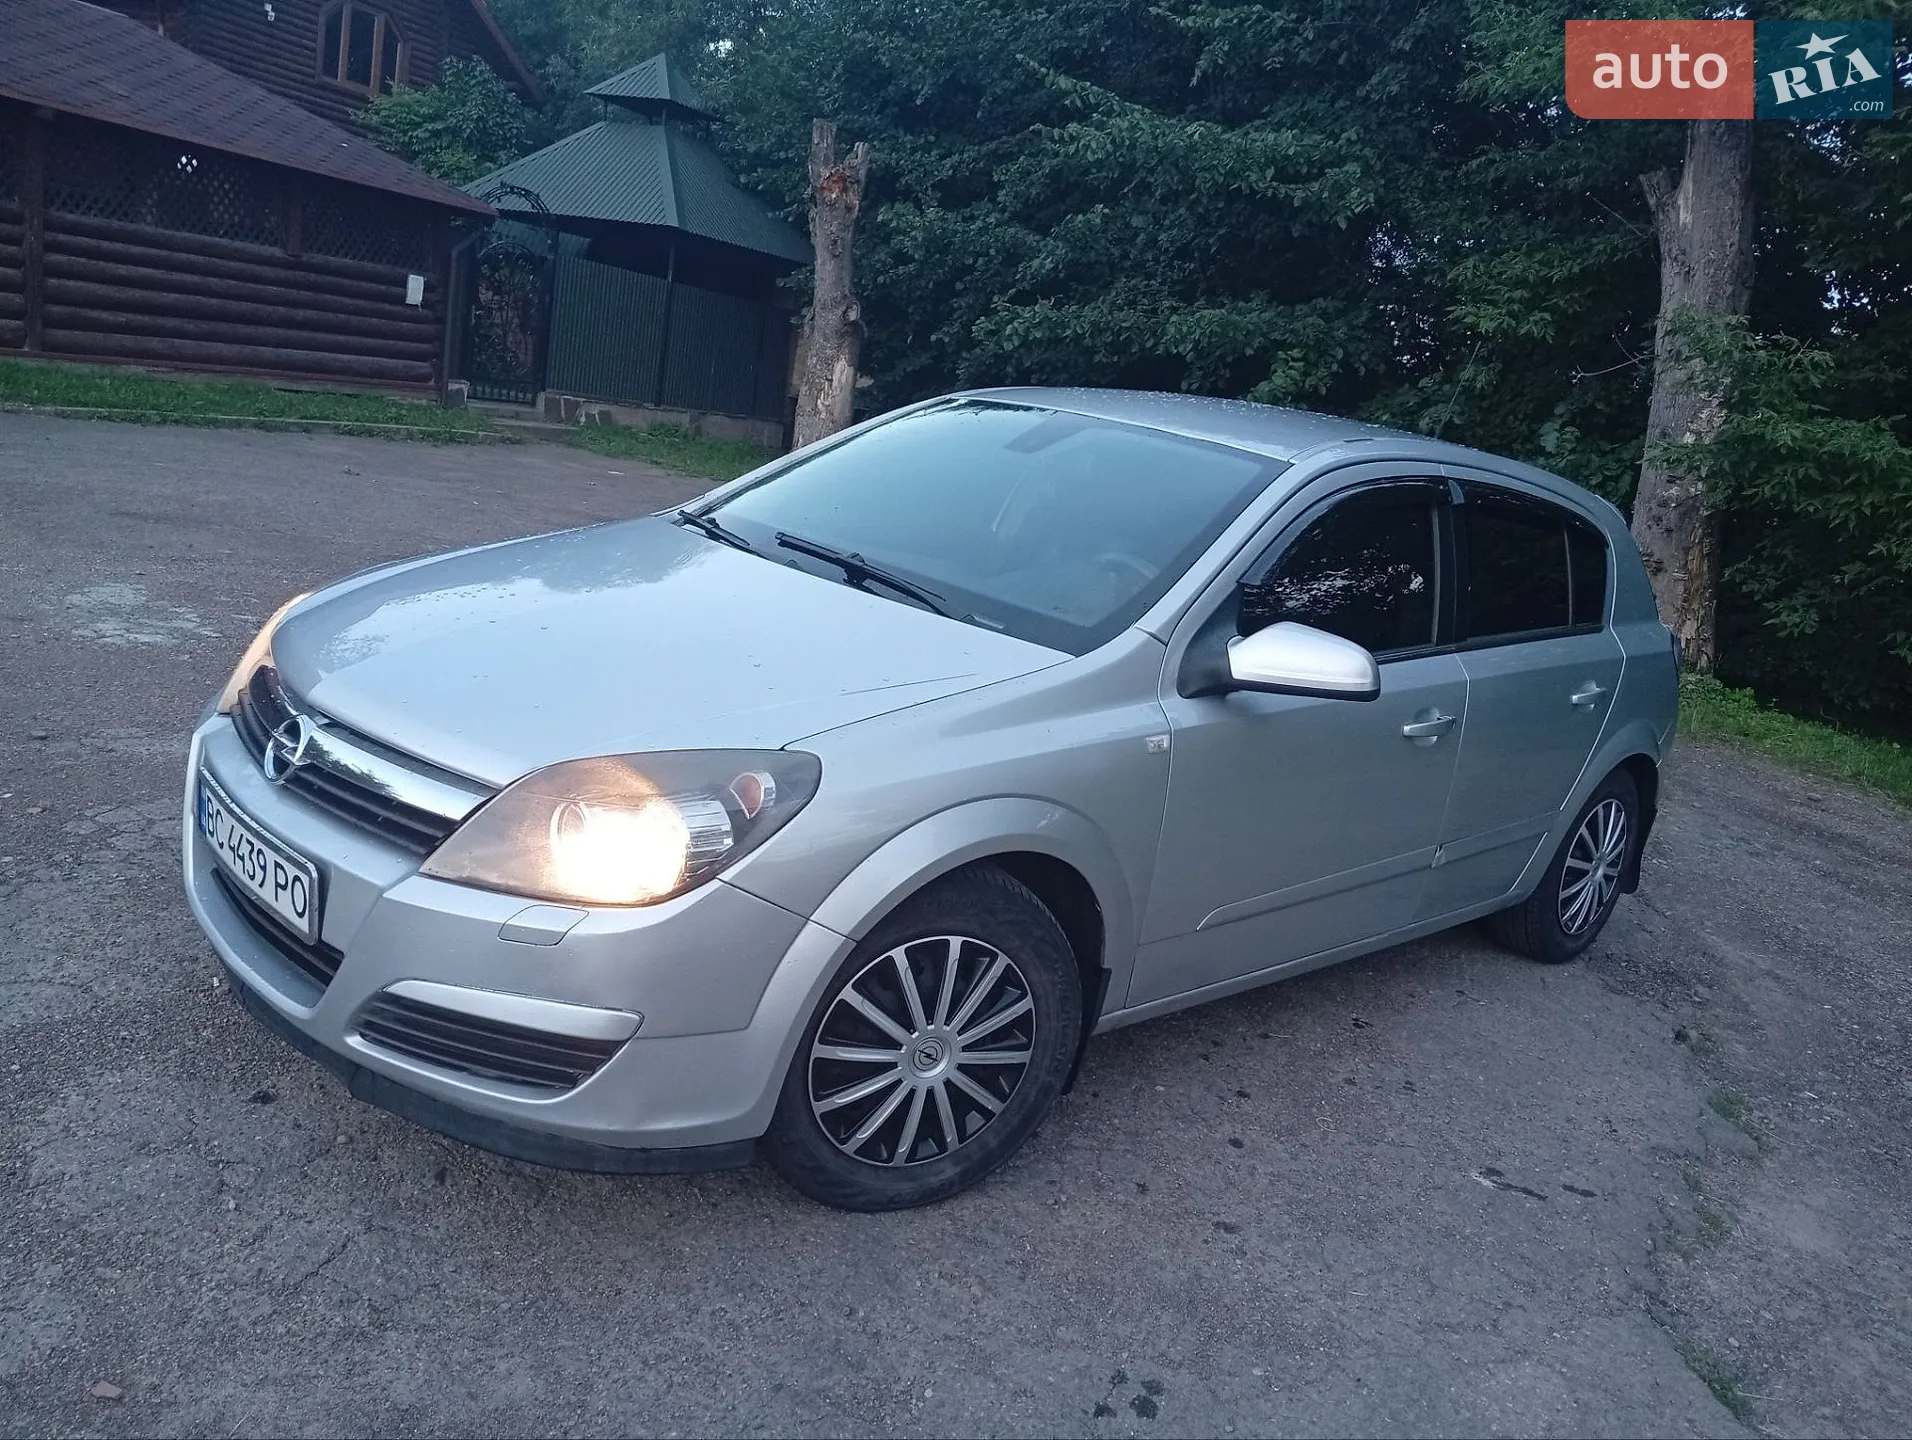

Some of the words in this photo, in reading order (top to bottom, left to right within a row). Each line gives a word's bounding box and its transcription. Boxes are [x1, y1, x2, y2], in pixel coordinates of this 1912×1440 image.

[207, 794, 224, 850] BC
[228, 824, 268, 888] 4439
[273, 859, 308, 919] PO
